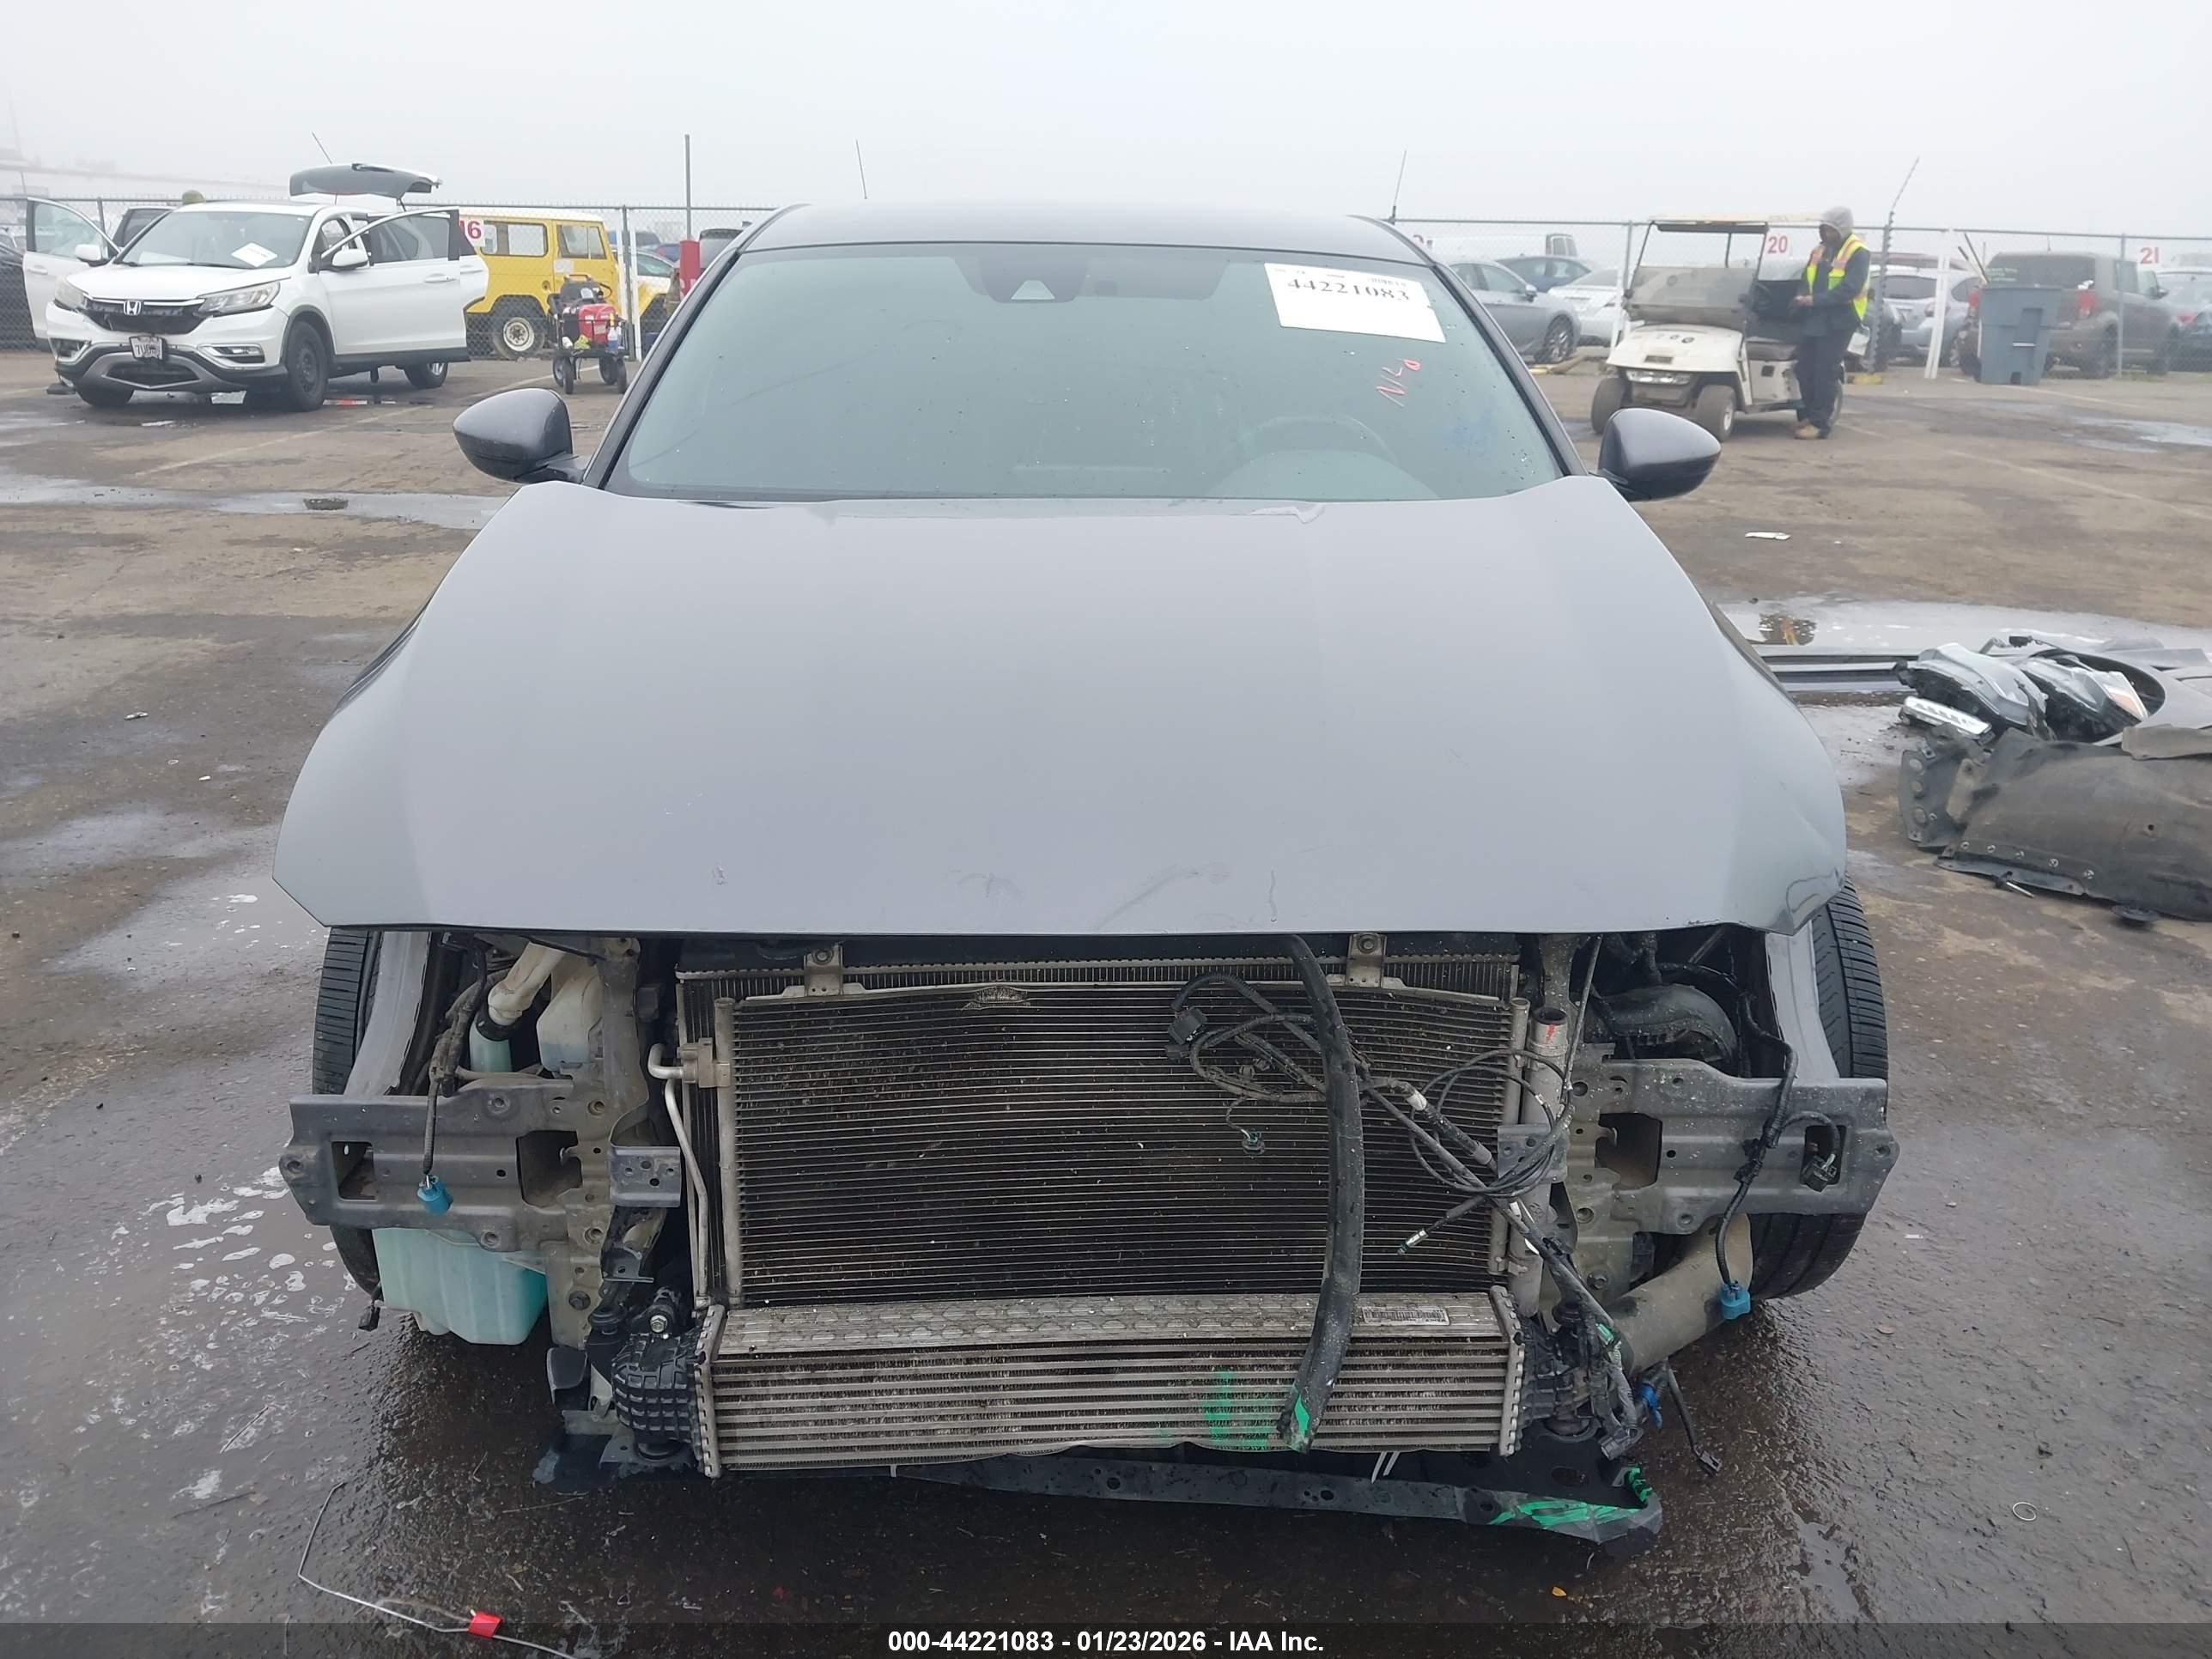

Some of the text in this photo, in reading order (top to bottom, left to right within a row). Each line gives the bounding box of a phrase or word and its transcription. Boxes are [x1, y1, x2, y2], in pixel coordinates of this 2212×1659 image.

[1767, 235, 1788, 254] 20
[2140, 246, 2160, 264] 21
[1287, 278, 1409, 301] 44221083
